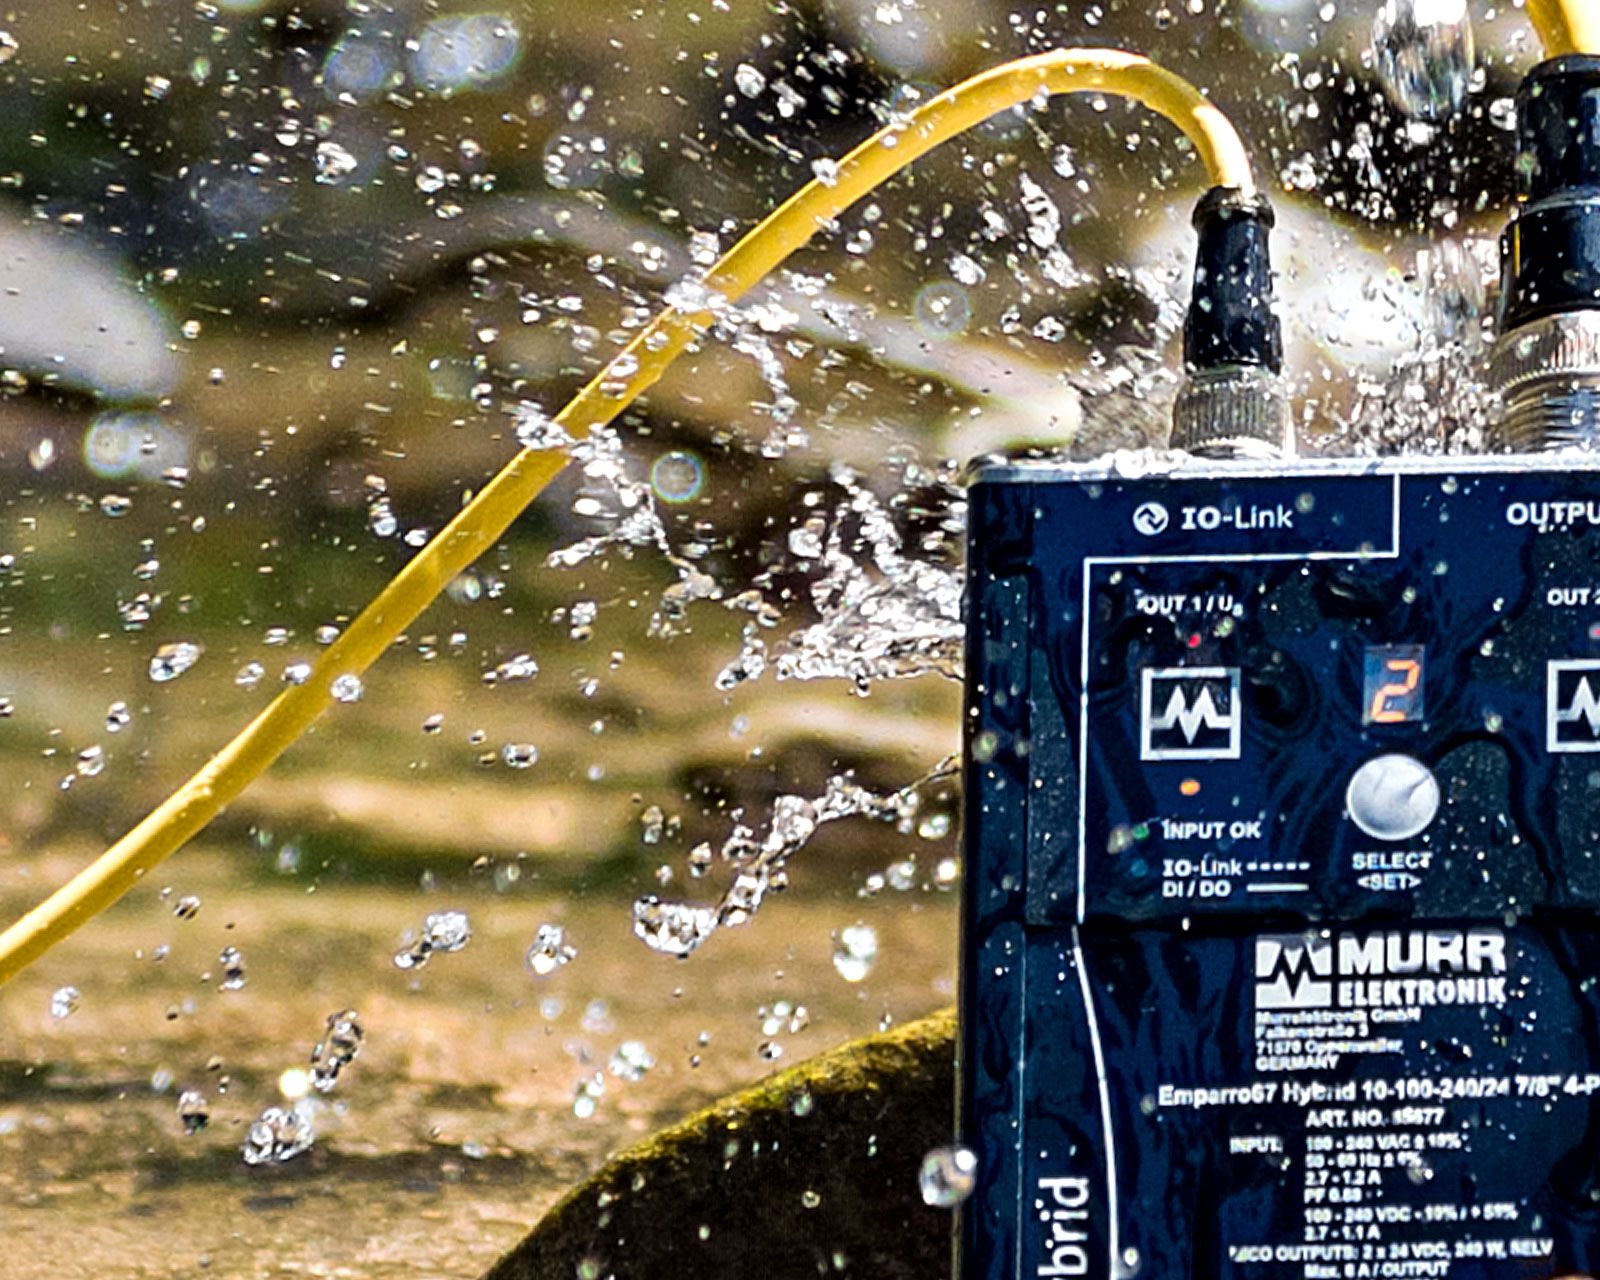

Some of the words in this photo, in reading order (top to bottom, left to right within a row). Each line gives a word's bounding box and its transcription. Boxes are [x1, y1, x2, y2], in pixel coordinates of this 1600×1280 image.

[1181, 504, 1293, 530] IO-Link
[1142, 594, 1186, 615] OUT
[1547, 587, 1591, 606] OUT
[1371, 660, 1420, 722] 2
[1162, 821, 1225, 840] INPUT
[1229, 821, 1262, 839] OK
[1162, 858, 1243, 877] IO-Link
[1352, 853, 1432, 870] SELECT
[1162, 881, 1183, 898] DI
[1199, 881, 1232, 898] DO
[1338, 931, 1506, 975] MURR
[1338, 977, 1506, 1006] ELEKTRONIK
[1371, 1008, 1421, 1023] GmbH
[1158, 1083, 1277, 1108] Emparro67
[1282, 1081, 1356, 1106] Hybrid
[1305, 1110, 1348, 1128] ART.
[1367, 1169, 1382, 1185] A
[1366, 1223, 1381, 1240] A
[1357, 1263, 1370, 1277] A
[1382, 1261, 1449, 1277] OUTPUT
